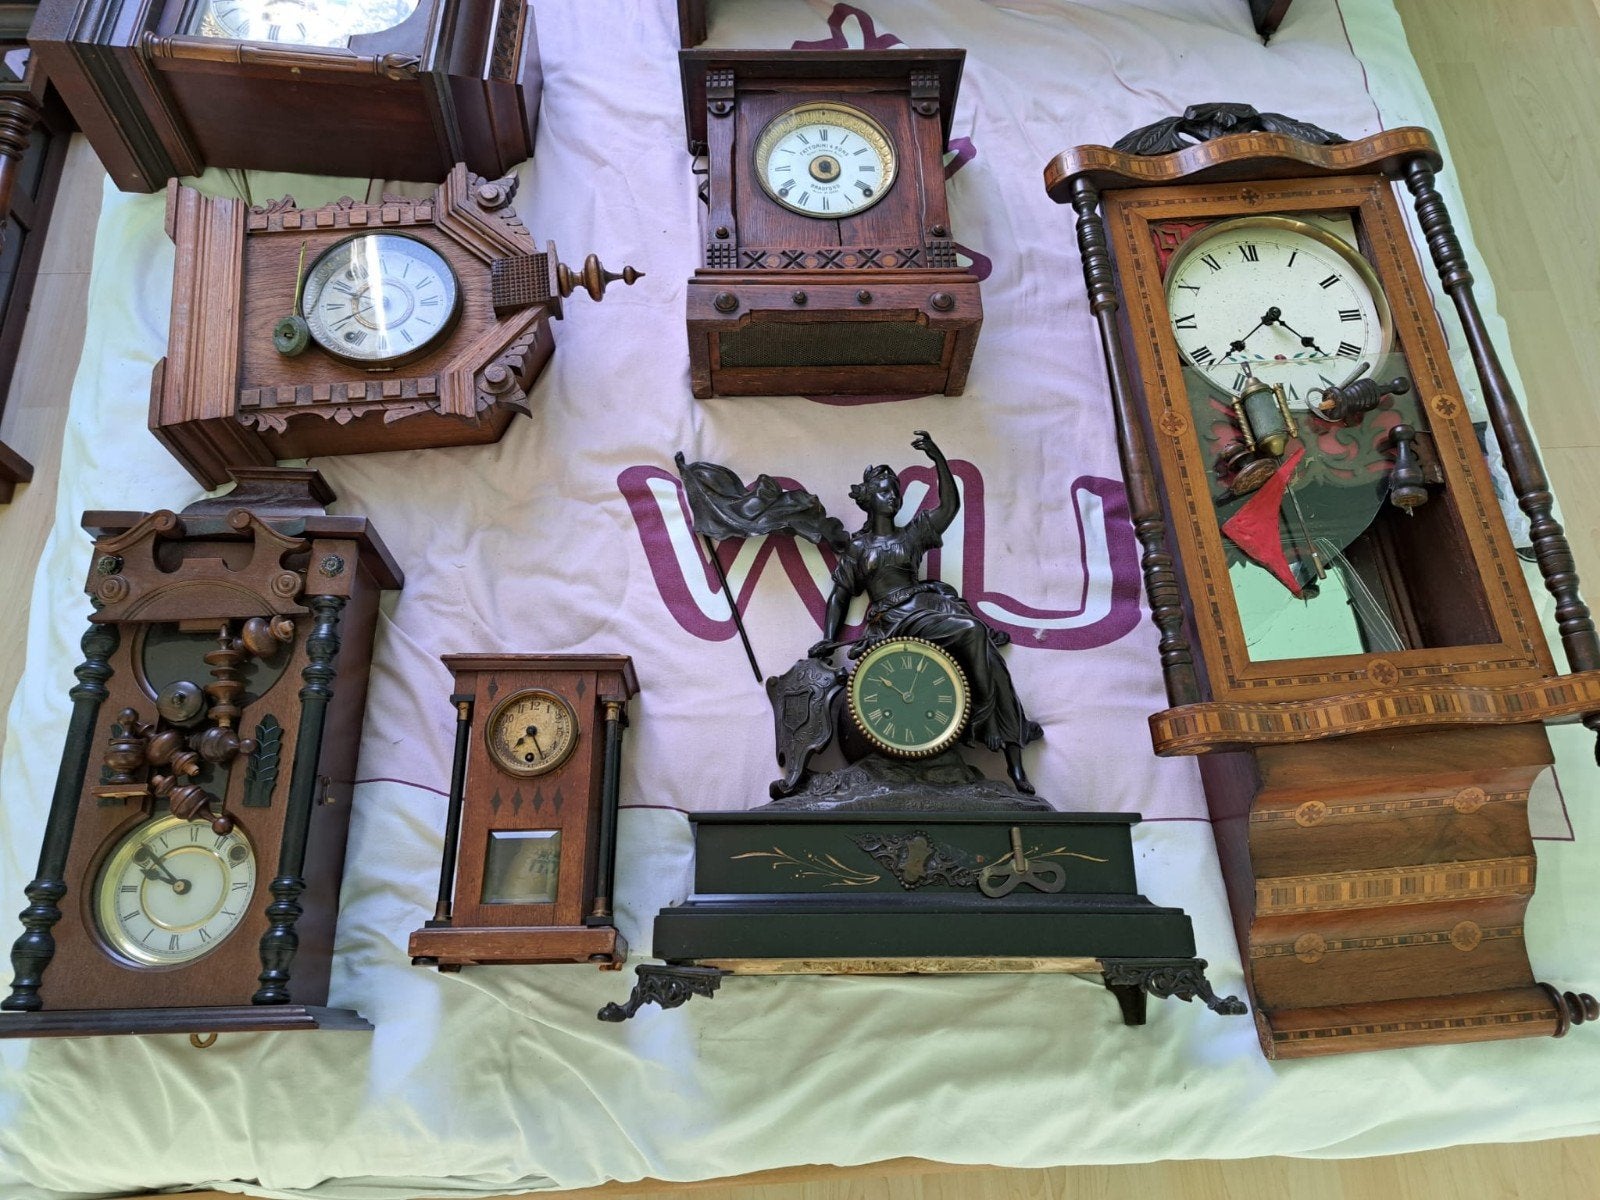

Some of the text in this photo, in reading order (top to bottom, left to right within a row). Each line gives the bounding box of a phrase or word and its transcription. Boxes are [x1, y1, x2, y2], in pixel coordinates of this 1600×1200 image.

[1239, 244, 1259, 263] XII
[1287, 251, 1297, 268] I
[1200, 253, 1222, 275] XI
[1178, 279, 1201, 297] X
[1318, 273, 1341, 290] II
[1172, 313, 1198, 330] IX
[1338, 309, 1362, 322] III
[1190, 346, 1217, 371] VIII
[901, 656, 912, 670] XII
[530, 700, 542, 711] 12
[938, 695, 952, 703] III
[517, 703, 525, 714] 11
[546, 704, 551, 714] 1
[504, 714, 514, 723] 10
[121, 885, 139, 893] III
[123, 910, 141, 921] II
